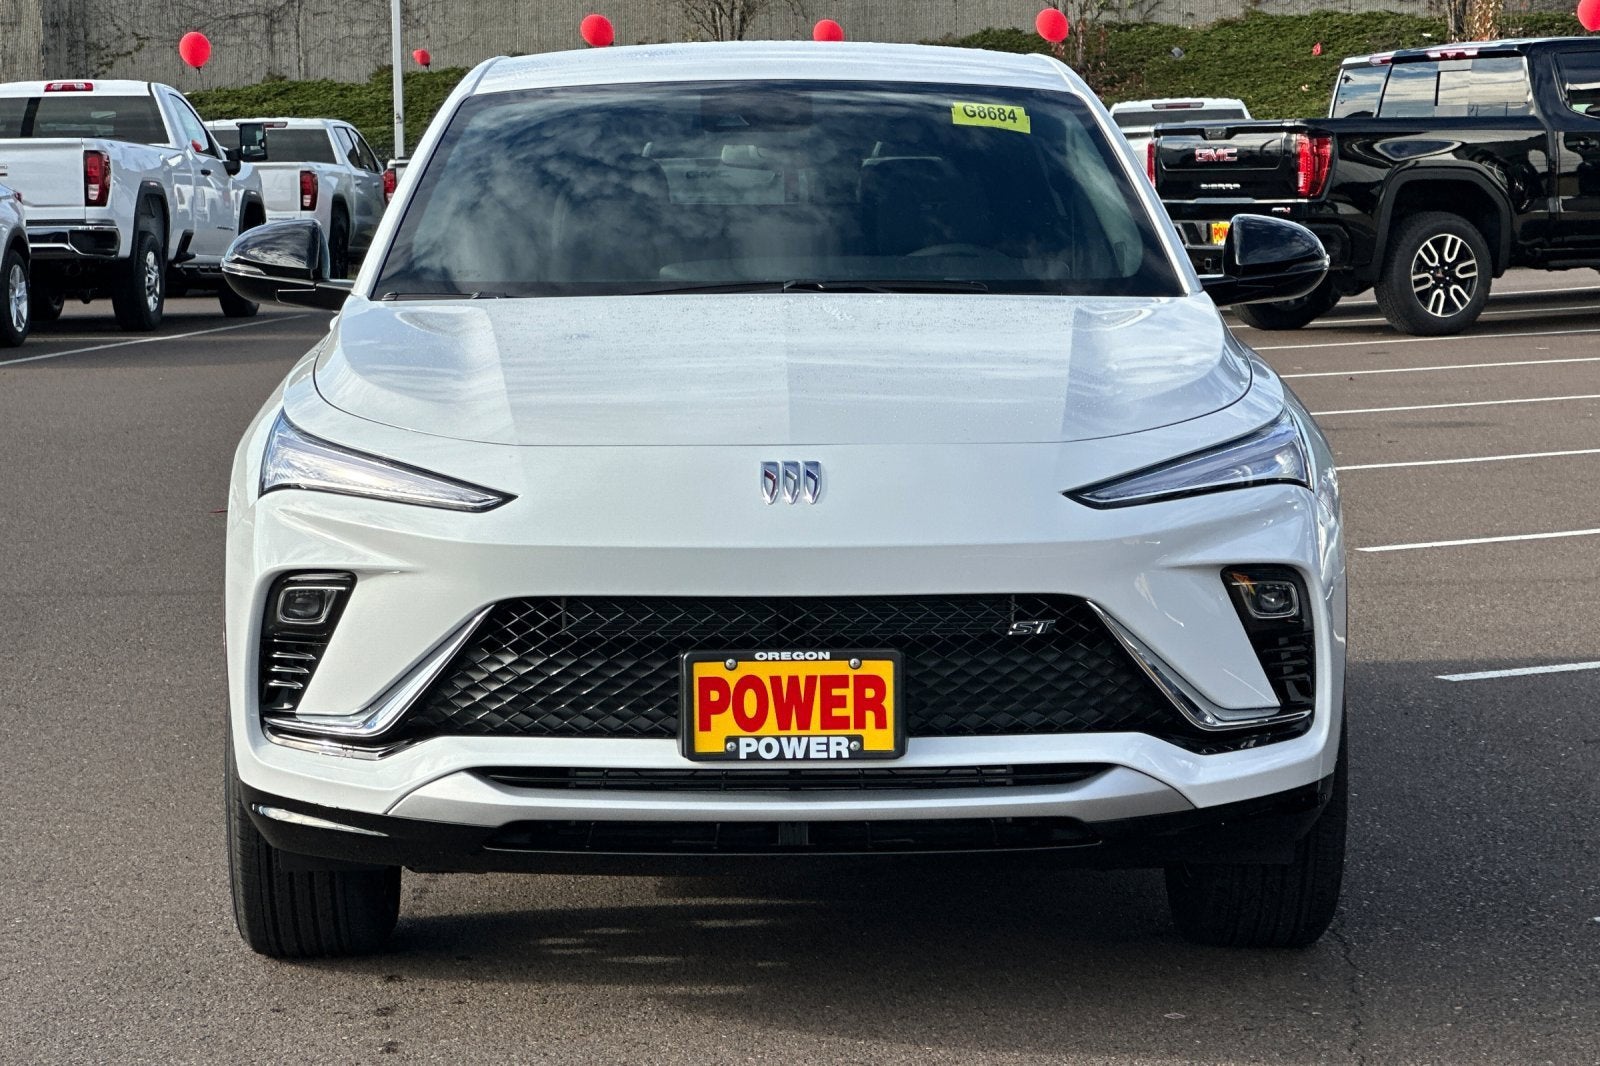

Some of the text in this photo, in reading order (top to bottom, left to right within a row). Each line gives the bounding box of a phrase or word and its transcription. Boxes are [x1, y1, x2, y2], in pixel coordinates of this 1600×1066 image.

[963, 105, 1017, 123] G8684
[1195, 148, 1238, 162] GMC
[1008, 619, 1056, 635] ST
[754, 651, 831, 661] OREGON
[698, 674, 887, 733] POWER
[739, 736, 850, 759] POWER
